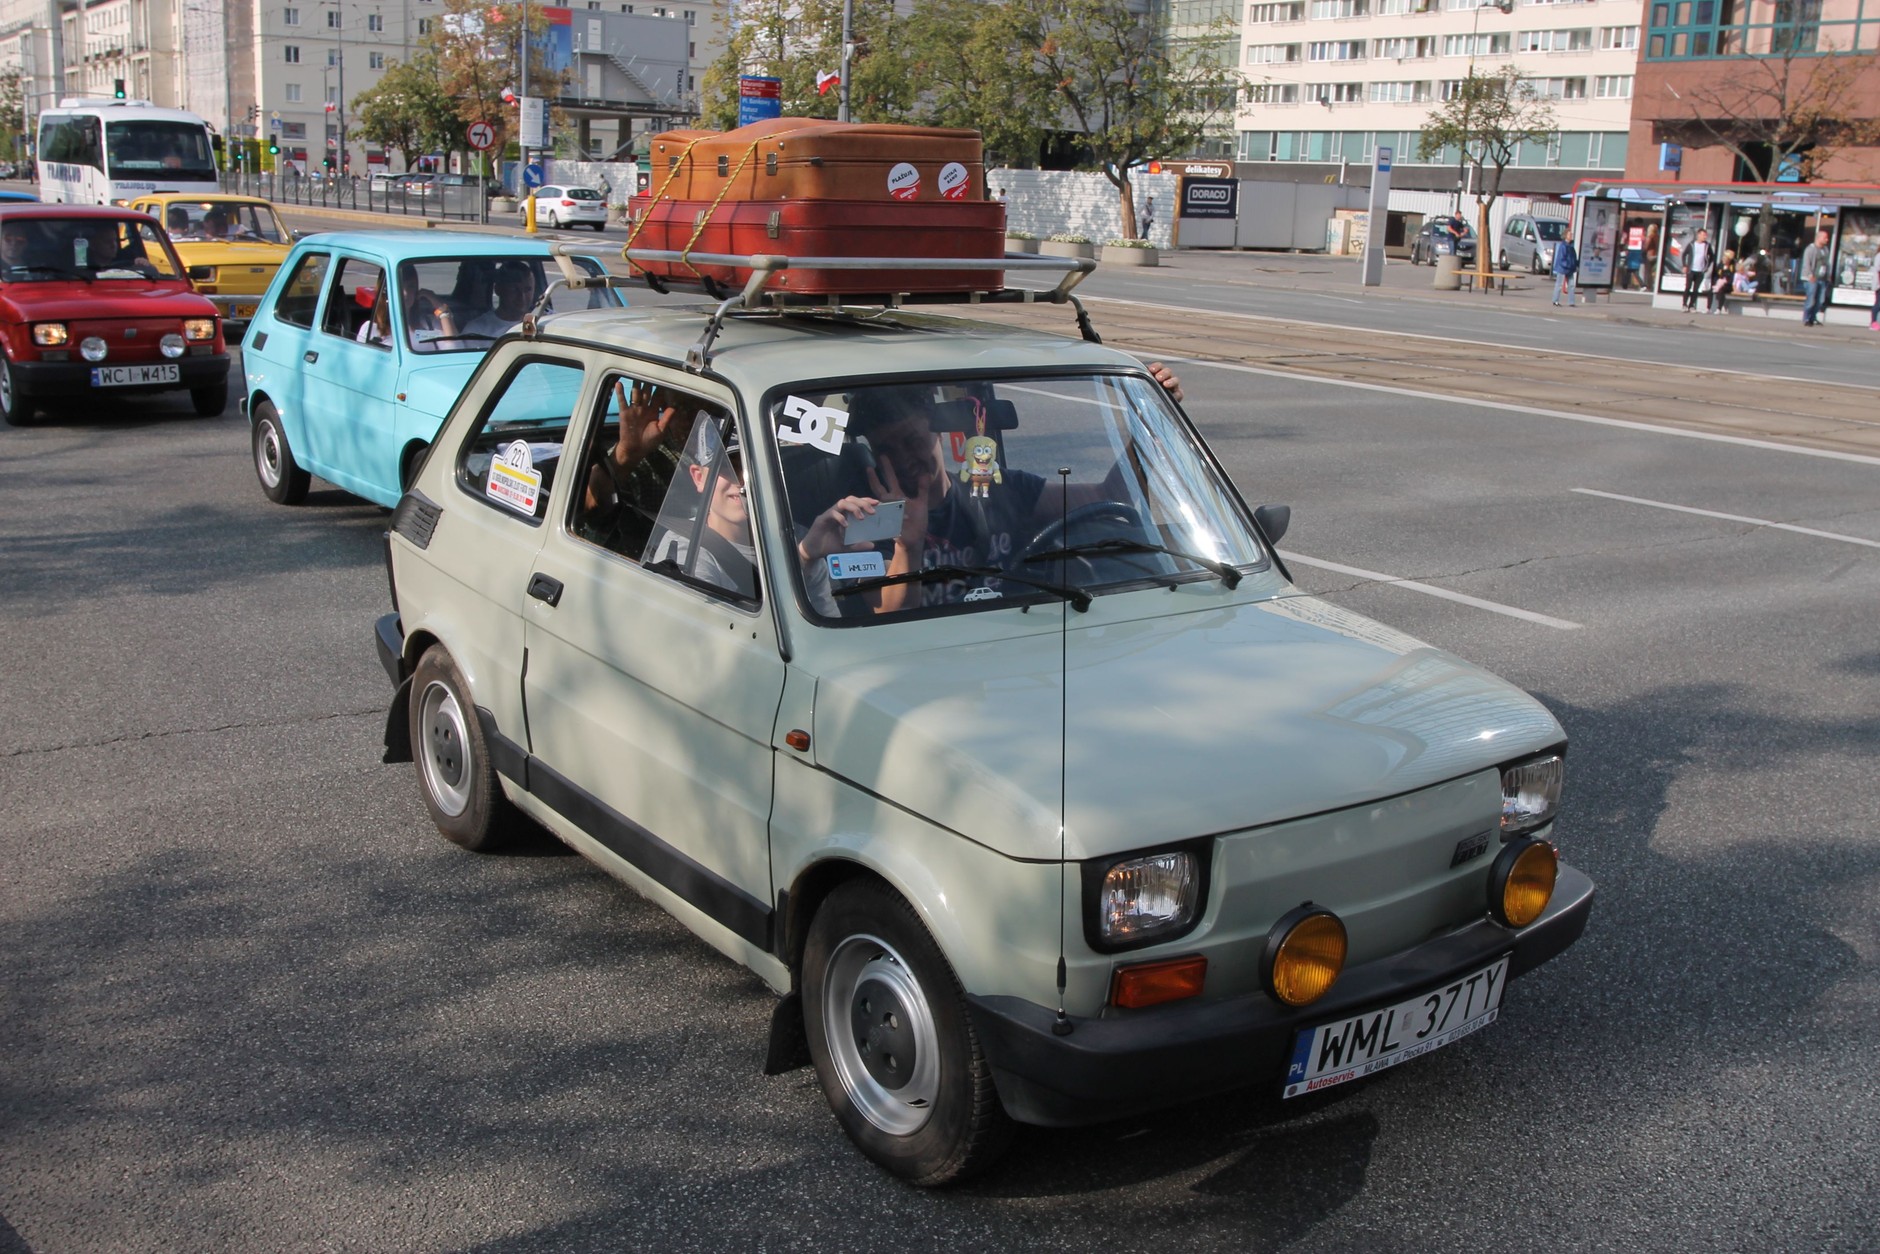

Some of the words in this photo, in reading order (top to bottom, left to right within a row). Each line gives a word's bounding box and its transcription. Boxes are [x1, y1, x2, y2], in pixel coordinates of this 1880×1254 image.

[1185, 165, 1222, 177] delikatesy
[1192, 190, 1226, 199] DORACO
[510, 447, 526, 470] 221
[848, 564, 861, 572] WML
[862, 563, 877, 572] 37TY
[1317, 1009, 1400, 1073] WML
[1416, 963, 1503, 1039] 37TY
[1288, 1063, 1304, 1077] PL
[1306, 1069, 1355, 1092] Autoservis
